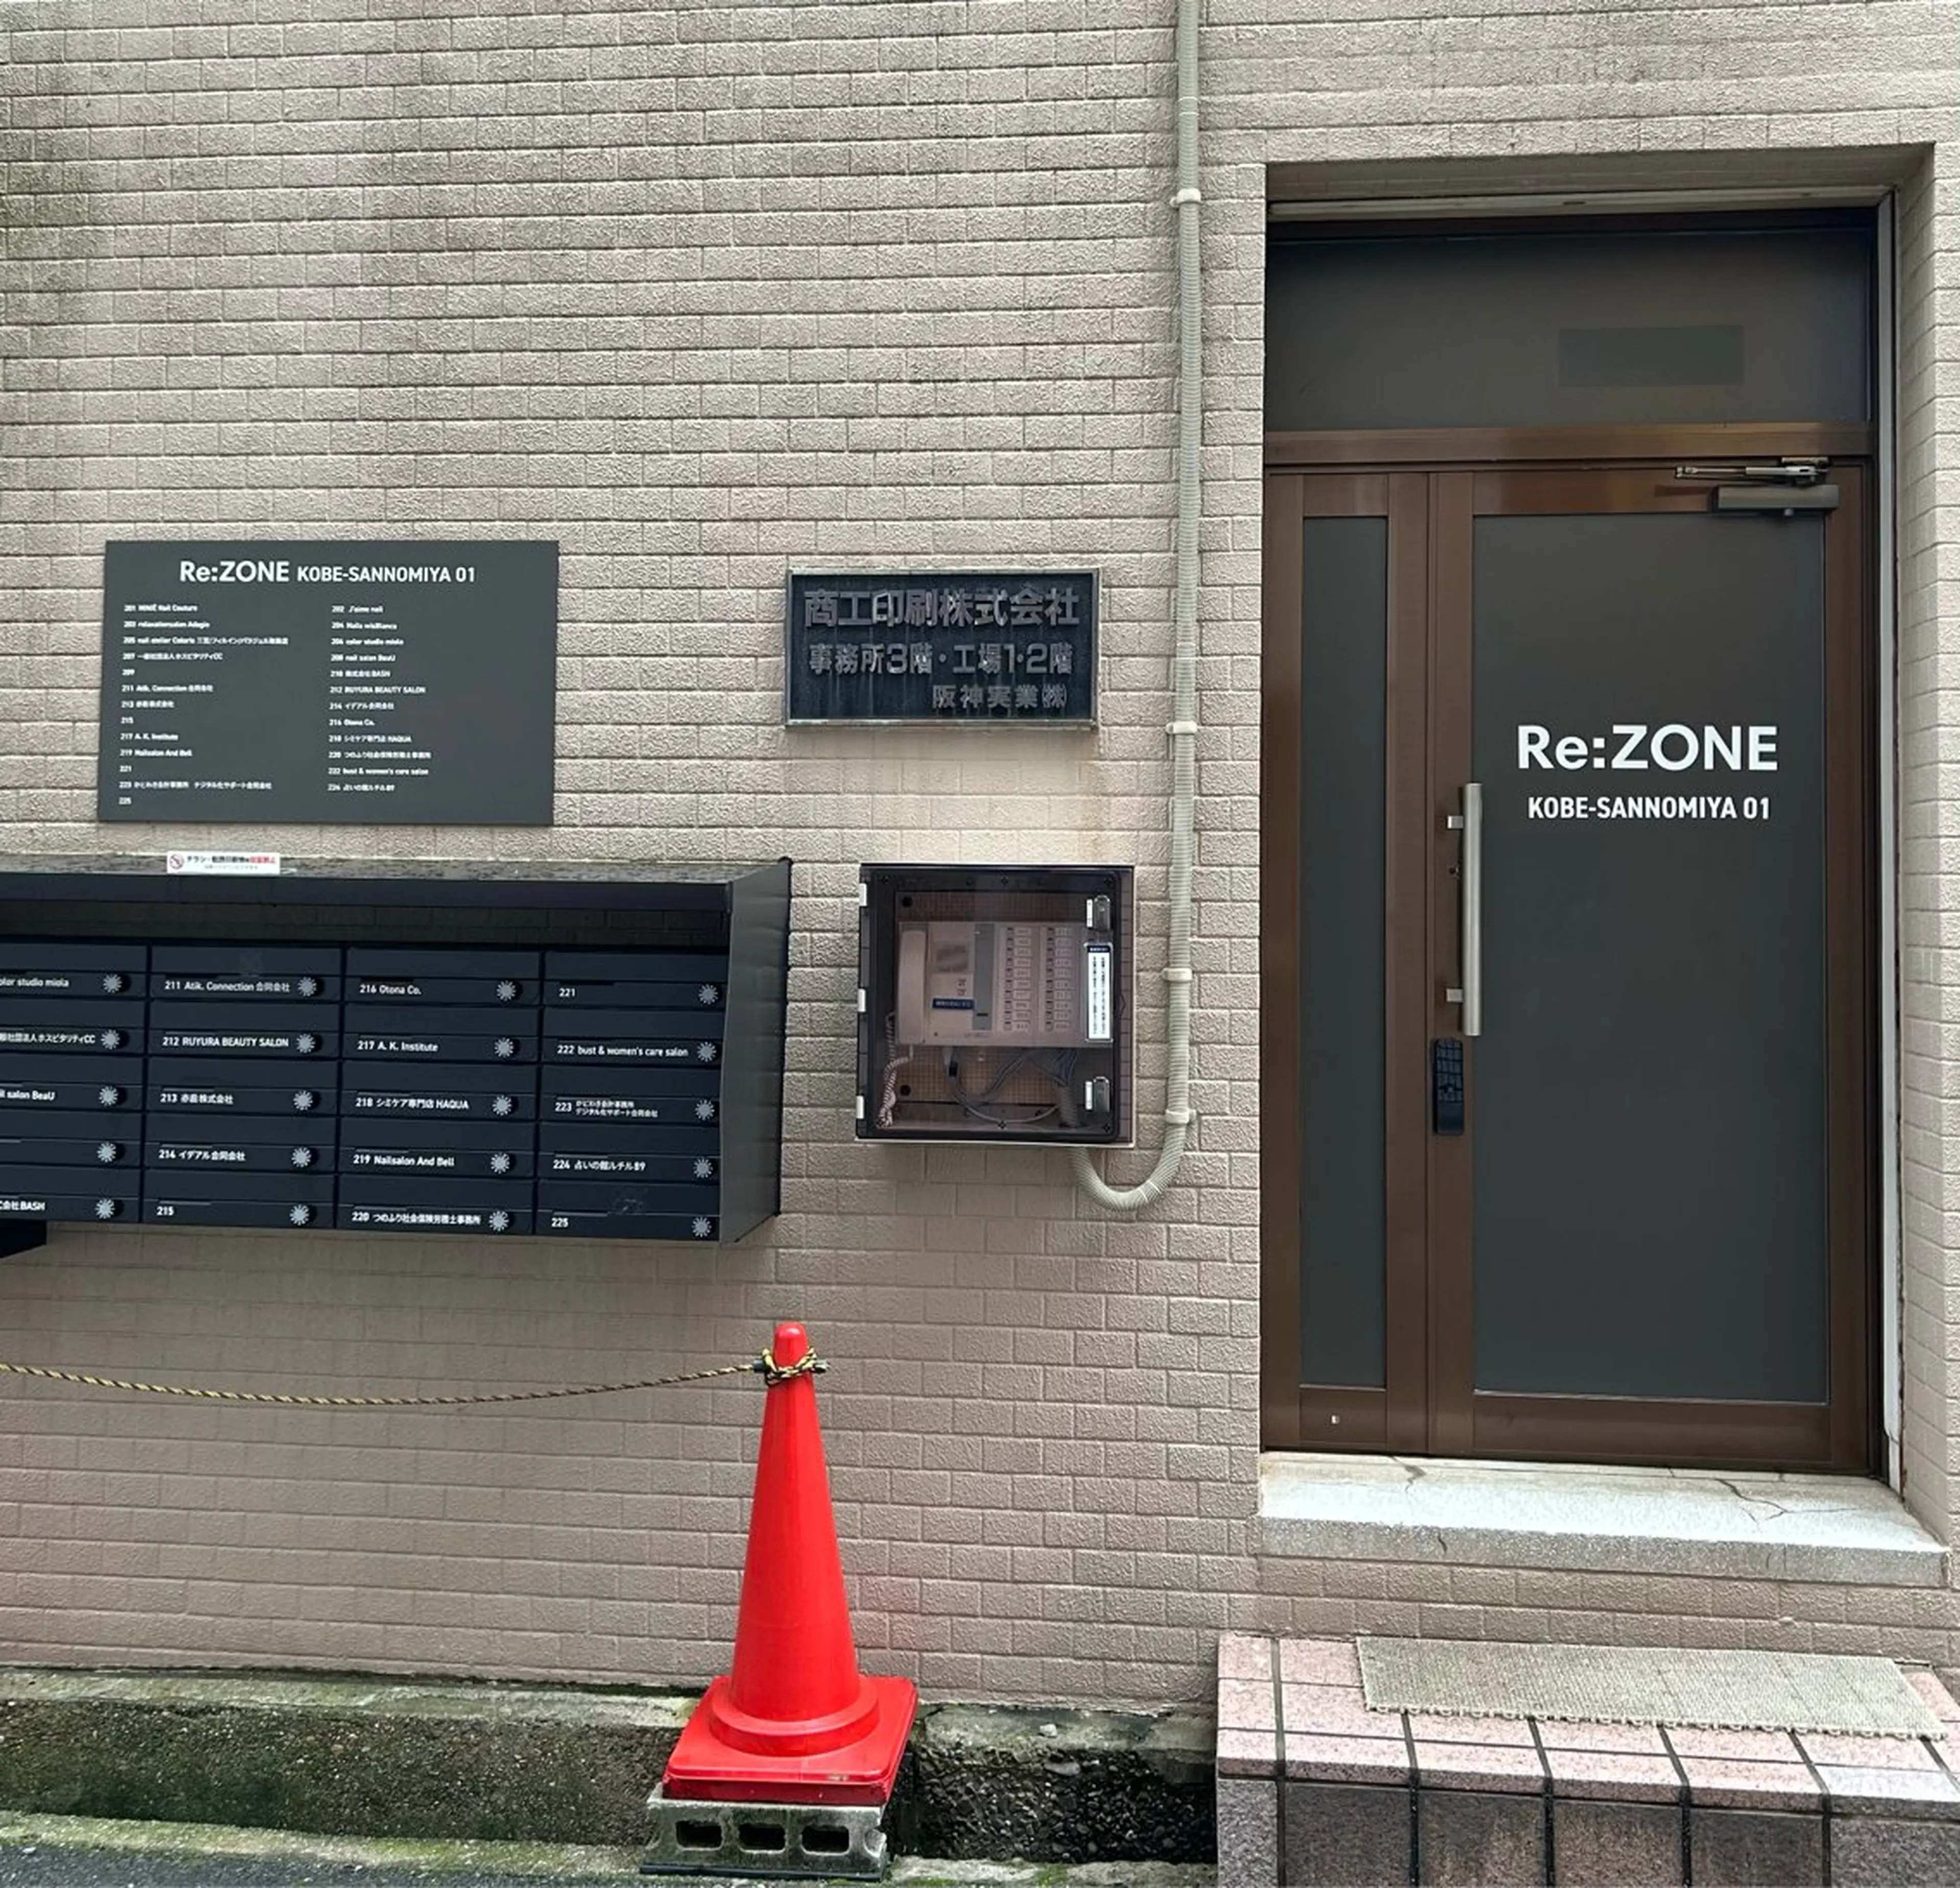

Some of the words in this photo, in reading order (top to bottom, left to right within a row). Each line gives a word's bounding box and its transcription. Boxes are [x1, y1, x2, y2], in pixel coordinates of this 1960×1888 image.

[180, 560, 289, 583] Re:ZONE
[297, 566, 452, 583] KOBE-SANNOMIYA
[455, 567, 475, 583] 01
[804, 587, 1080, 627] 商工印刷株式会社
[329, 735, 342, 743] 218
[1517, 723, 1778, 771] Re:ZONE
[165, 749, 179, 757] And
[1528, 796, 1737, 819] KOBE-SANNOMIYA
[1743, 796, 1770, 820] 01
[17, 978, 44, 987] studio
[165, 980, 180, 990] 211
[206, 981, 254, 991] Connection
[256, 981, 290, 993] 合同会社
[359, 984, 377, 994] 216
[379, 984, 406, 995] Otona
[407, 985, 422, 995] Co.
[559, 987, 576, 997] 221
[162, 1036, 180, 1047] 212
[182, 1036, 220, 1047] RUYURA
[222, 1037, 257, 1047] BEAUTY
[259, 1037, 289, 1048] SALON
[357, 1039, 376, 1050] 217
[377, 1041, 387, 1051] A.
[389, 1041, 400, 1051] K.
[401, 1041, 439, 1052] Institute
[557, 1045, 575, 1055] 222
[577, 1045, 597, 1055] bust
[598, 1045, 605, 1055] &
[606, 1046, 644, 1056] women's
[645, 1049, 664, 1057] care
[665, 1047, 689, 1057] salon
[7, 1090, 31, 1100] salon
[32, 1090, 56, 1101] BeaU
[160, 1093, 178, 1103] 213
[355, 1097, 374, 1107] 218
[376, 1098, 434, 1109] シミケア専門店
[435, 1099, 470, 1110] HAQUA
[555, 1101, 572, 1112] 223
[158, 1149, 177, 1159] 214
[178, 1150, 246, 1161] イデアル合同会社
[352, 1154, 372, 1164] 219
[373, 1155, 415, 1166] Nailsalon
[416, 1156, 436, 1167] And
[552, 1159, 571, 1170] 224
[156, 1206, 175, 1216] 215
[351, 1211, 370, 1222] 220
[551, 1217, 569, 1228] 225
